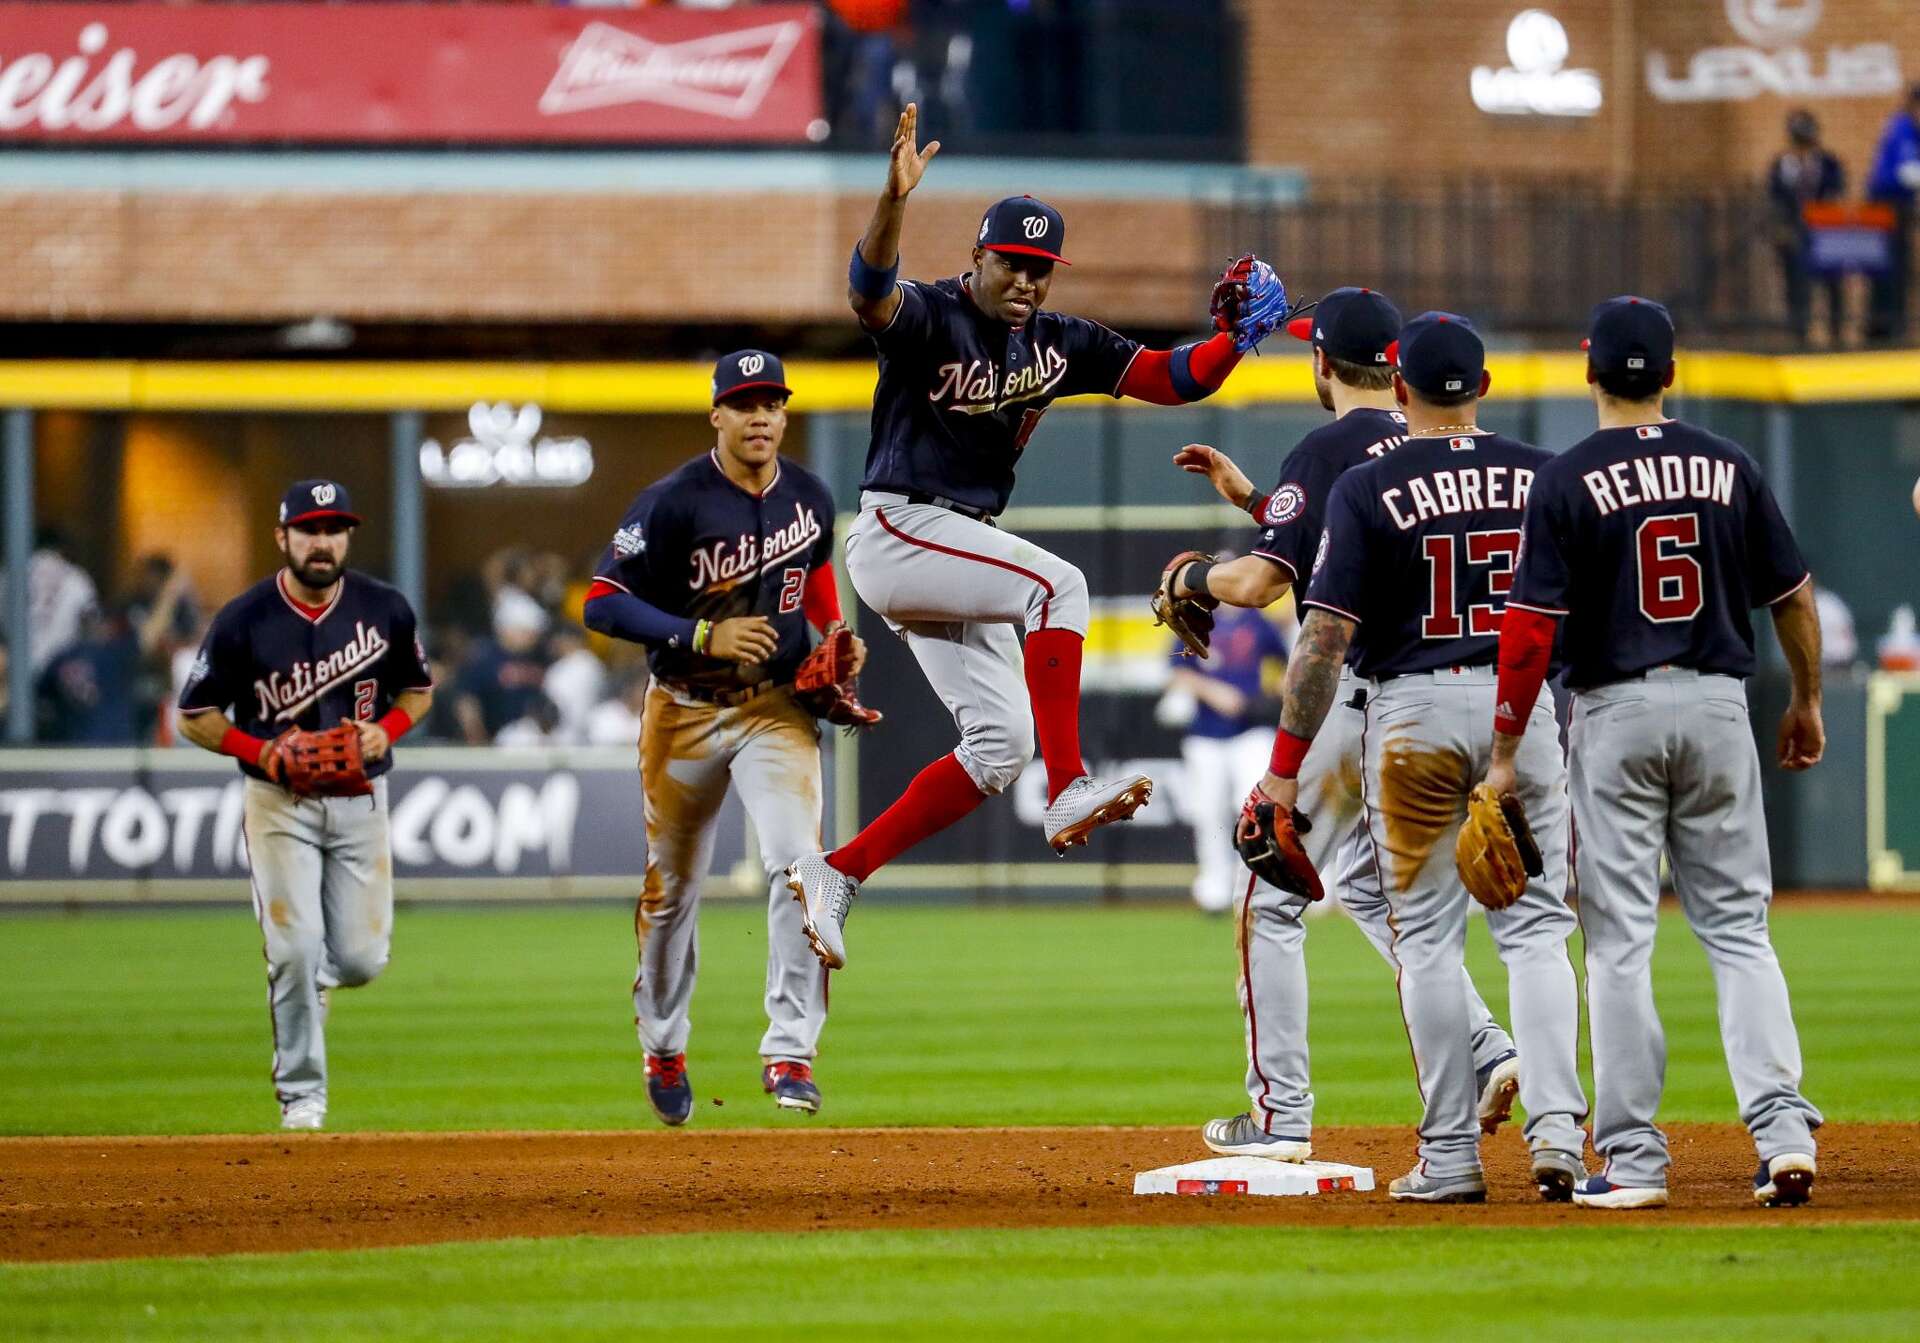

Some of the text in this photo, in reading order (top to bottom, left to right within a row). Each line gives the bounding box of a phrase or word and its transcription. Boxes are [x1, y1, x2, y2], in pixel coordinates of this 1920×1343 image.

[1382, 466, 1535, 530] CABRER
[1583, 455, 1736, 517] RENDON
[689, 501, 821, 590] Nationals
[1422, 527, 1524, 640] 13
[1636, 512, 1705, 624] 6
[254, 622, 390, 722] Nationals
[354, 679, 378, 722] 2
